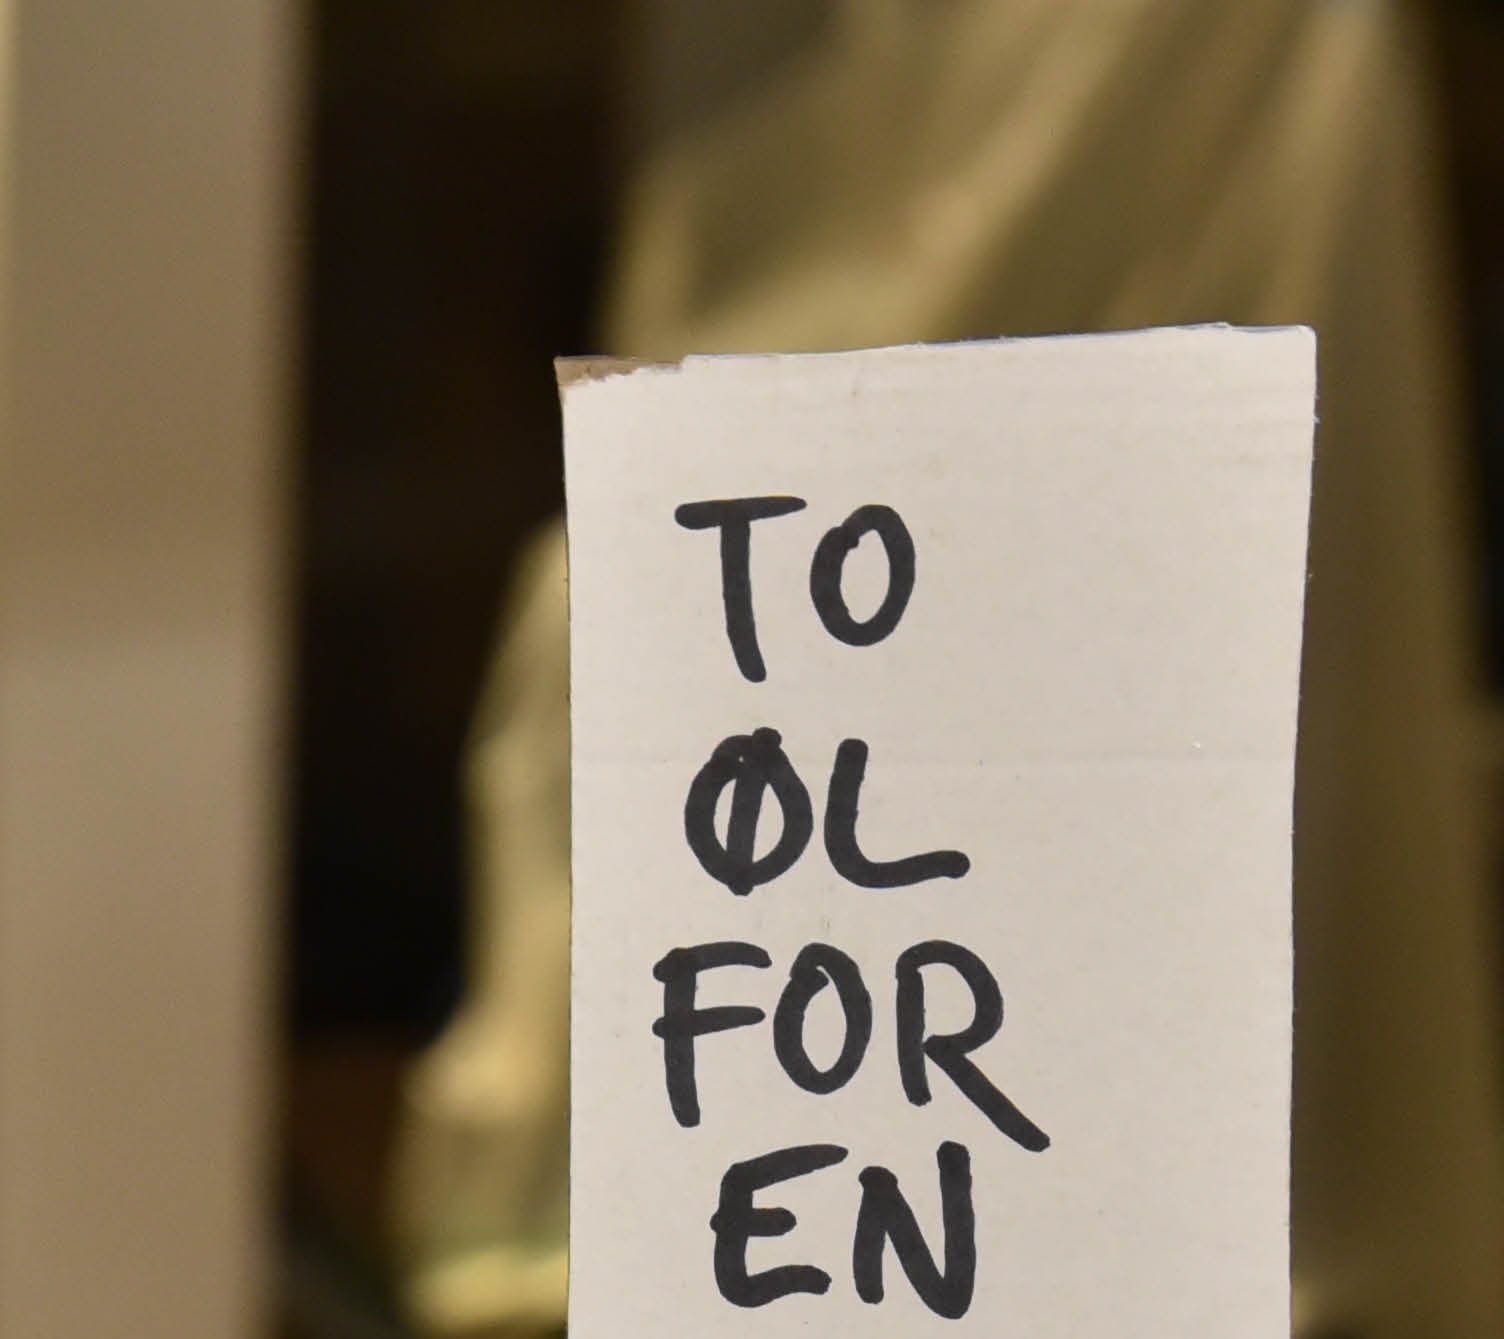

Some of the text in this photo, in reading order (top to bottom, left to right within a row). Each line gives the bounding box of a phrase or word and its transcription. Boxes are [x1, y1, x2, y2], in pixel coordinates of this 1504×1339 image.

[675, 497, 915, 682] TO
[685, 727, 970, 896] ØL
[653, 940, 1050, 1153] FOR
[710, 1141, 976, 1319] EN
